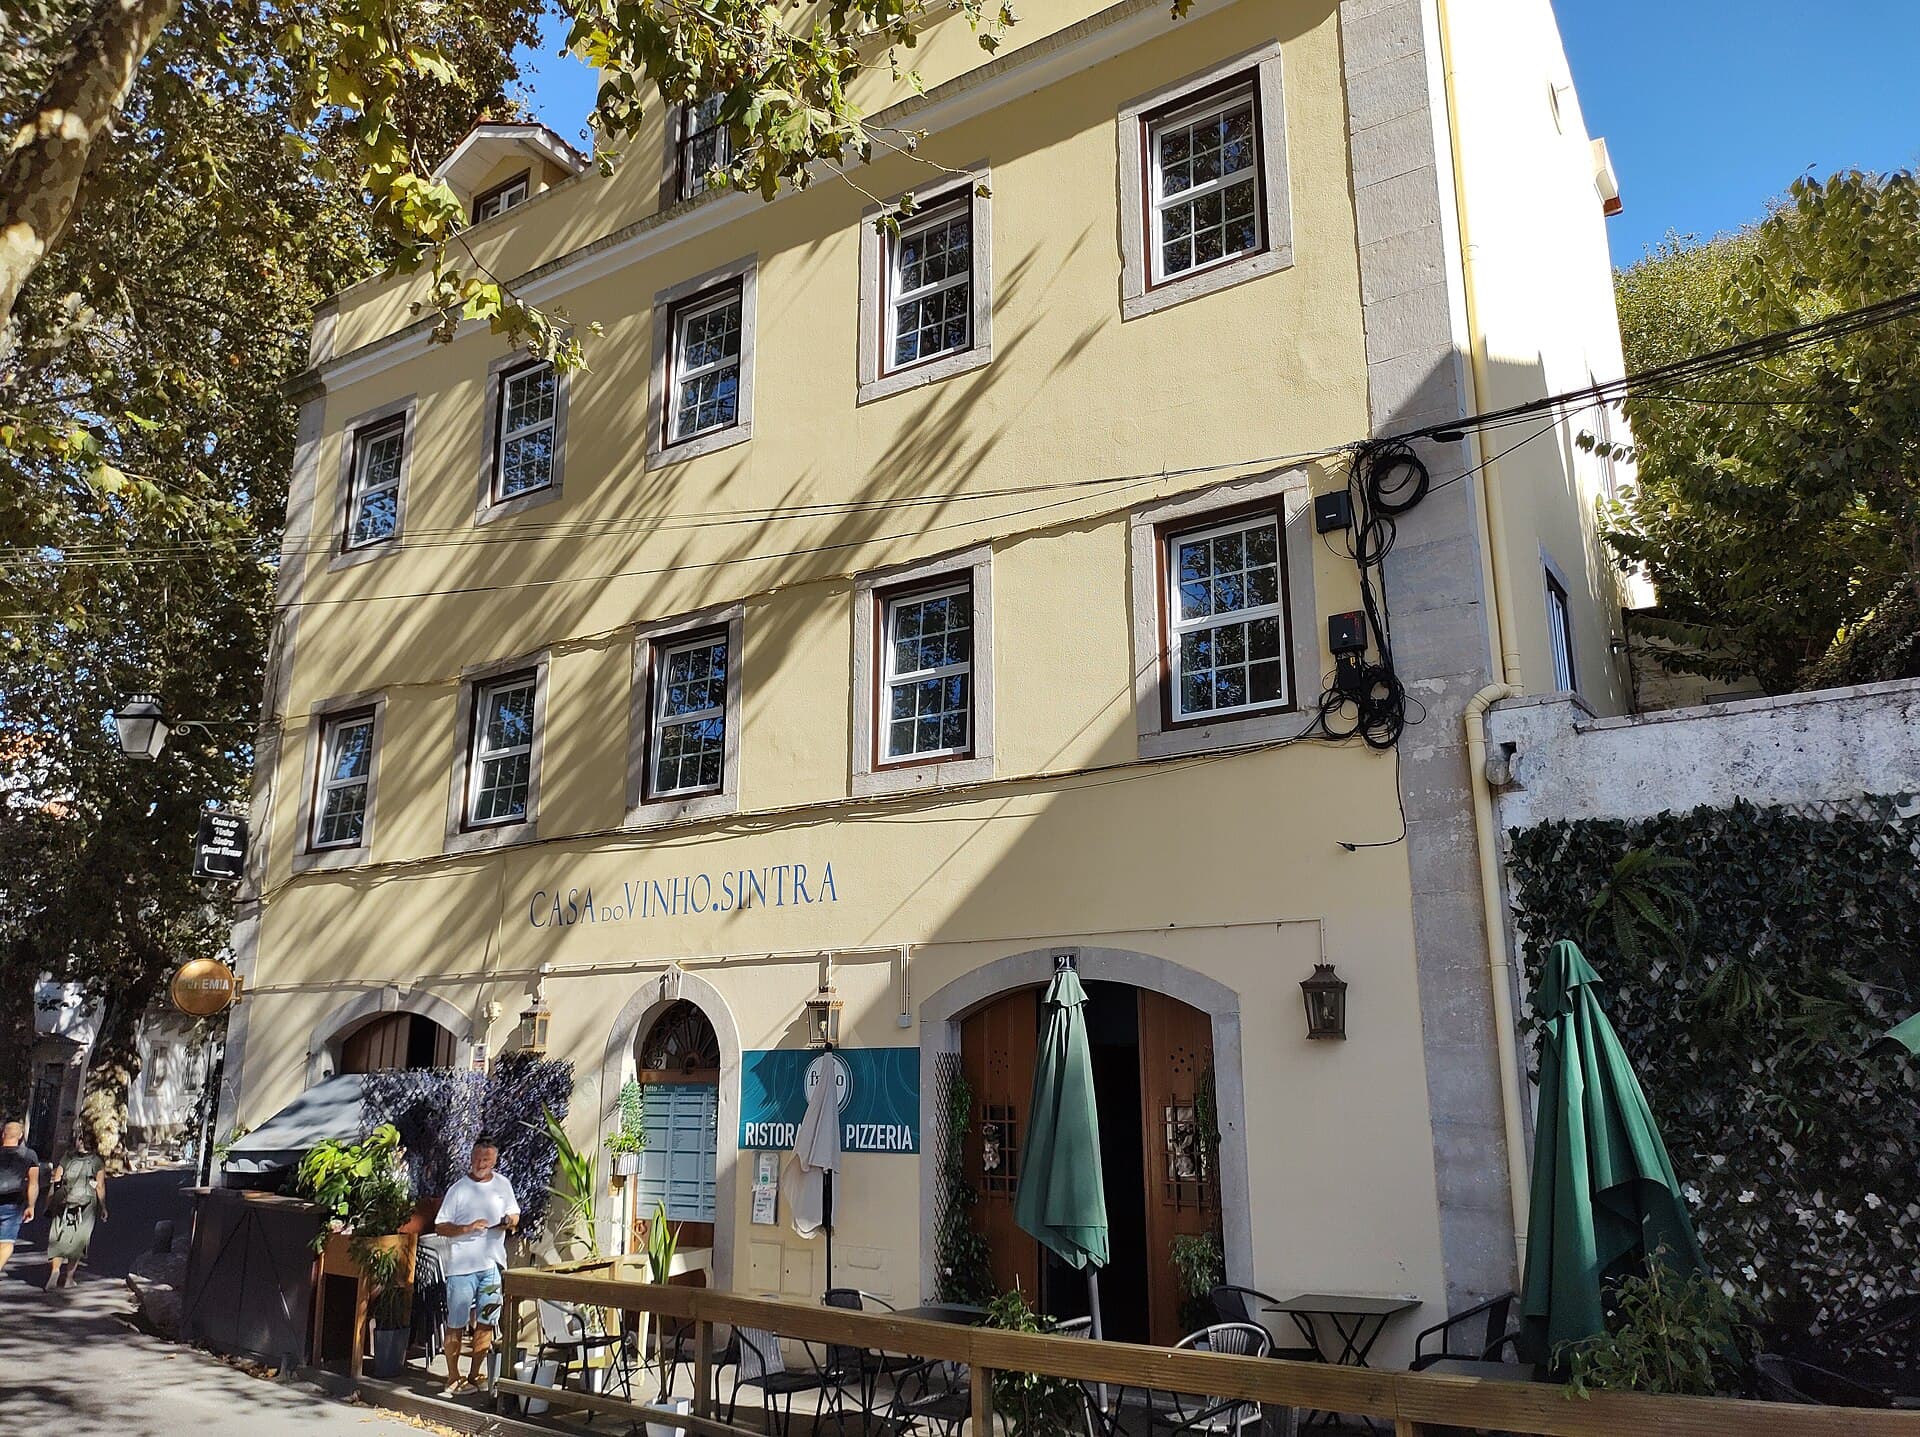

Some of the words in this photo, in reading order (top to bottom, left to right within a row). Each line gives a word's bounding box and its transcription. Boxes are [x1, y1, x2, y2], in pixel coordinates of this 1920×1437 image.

[529, 887, 596, 928] CASA
[601, 905, 623, 922] DO
[1058, 955, 1071, 969] 21
[846, 1124, 913, 1150] PIZZERIA
